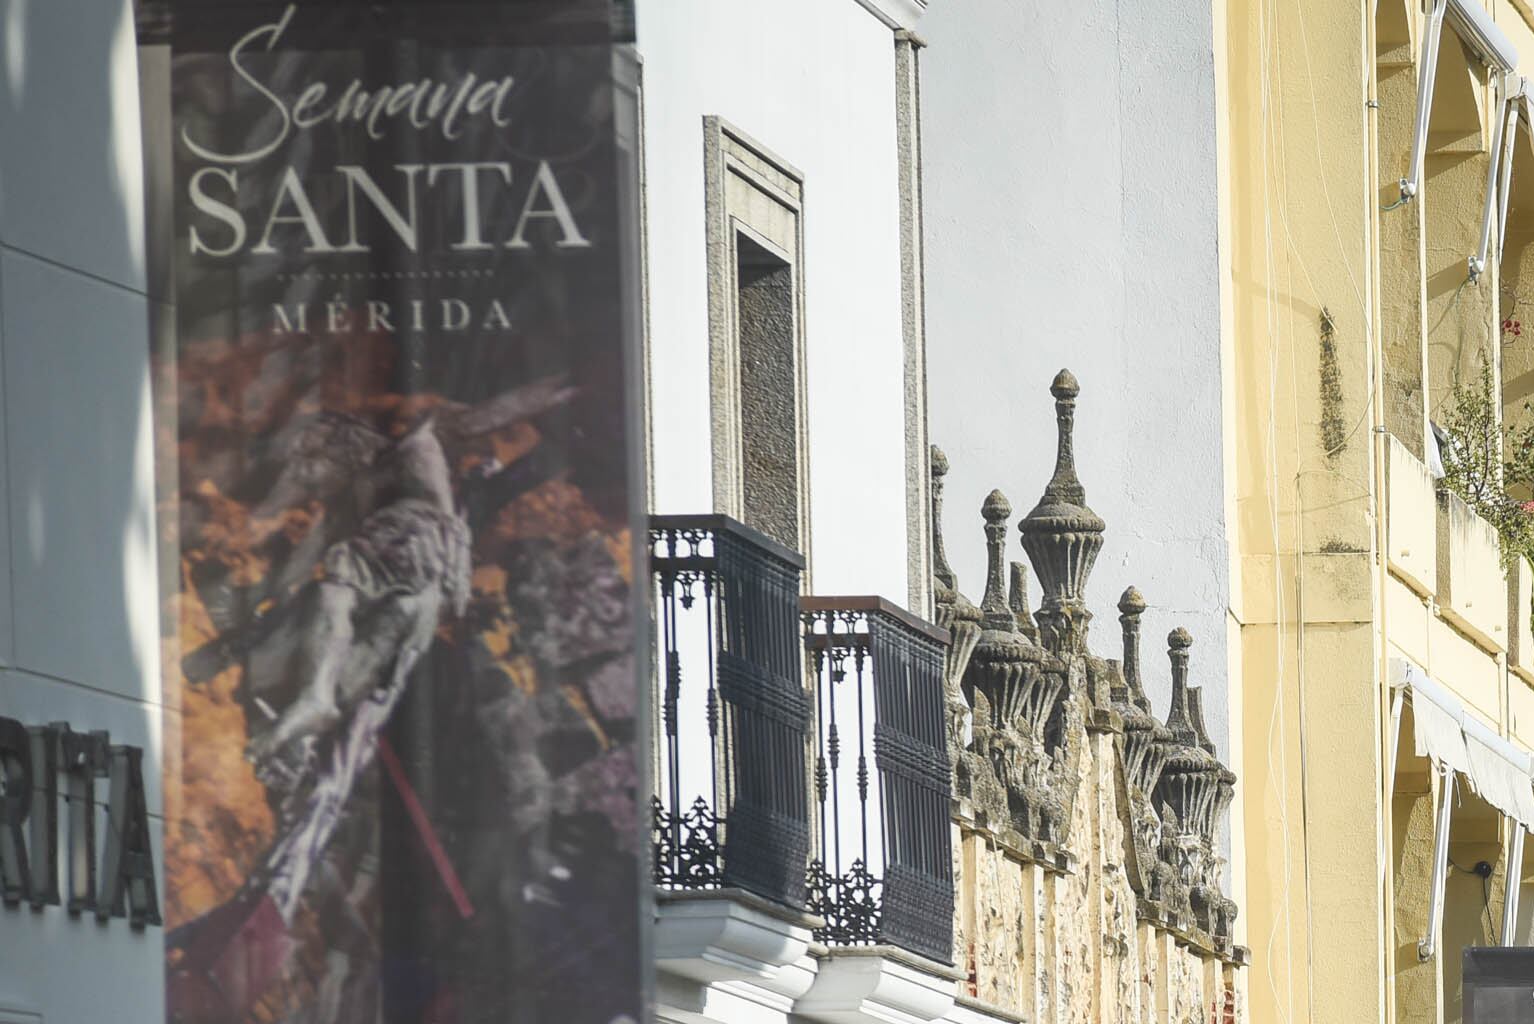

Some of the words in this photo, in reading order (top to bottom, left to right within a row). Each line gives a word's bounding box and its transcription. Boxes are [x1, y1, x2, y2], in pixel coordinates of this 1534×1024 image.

[181, 3, 515, 163] Semana
[188, 159, 592, 257] SANTA
[272, 292, 514, 335] MÉRIDA
